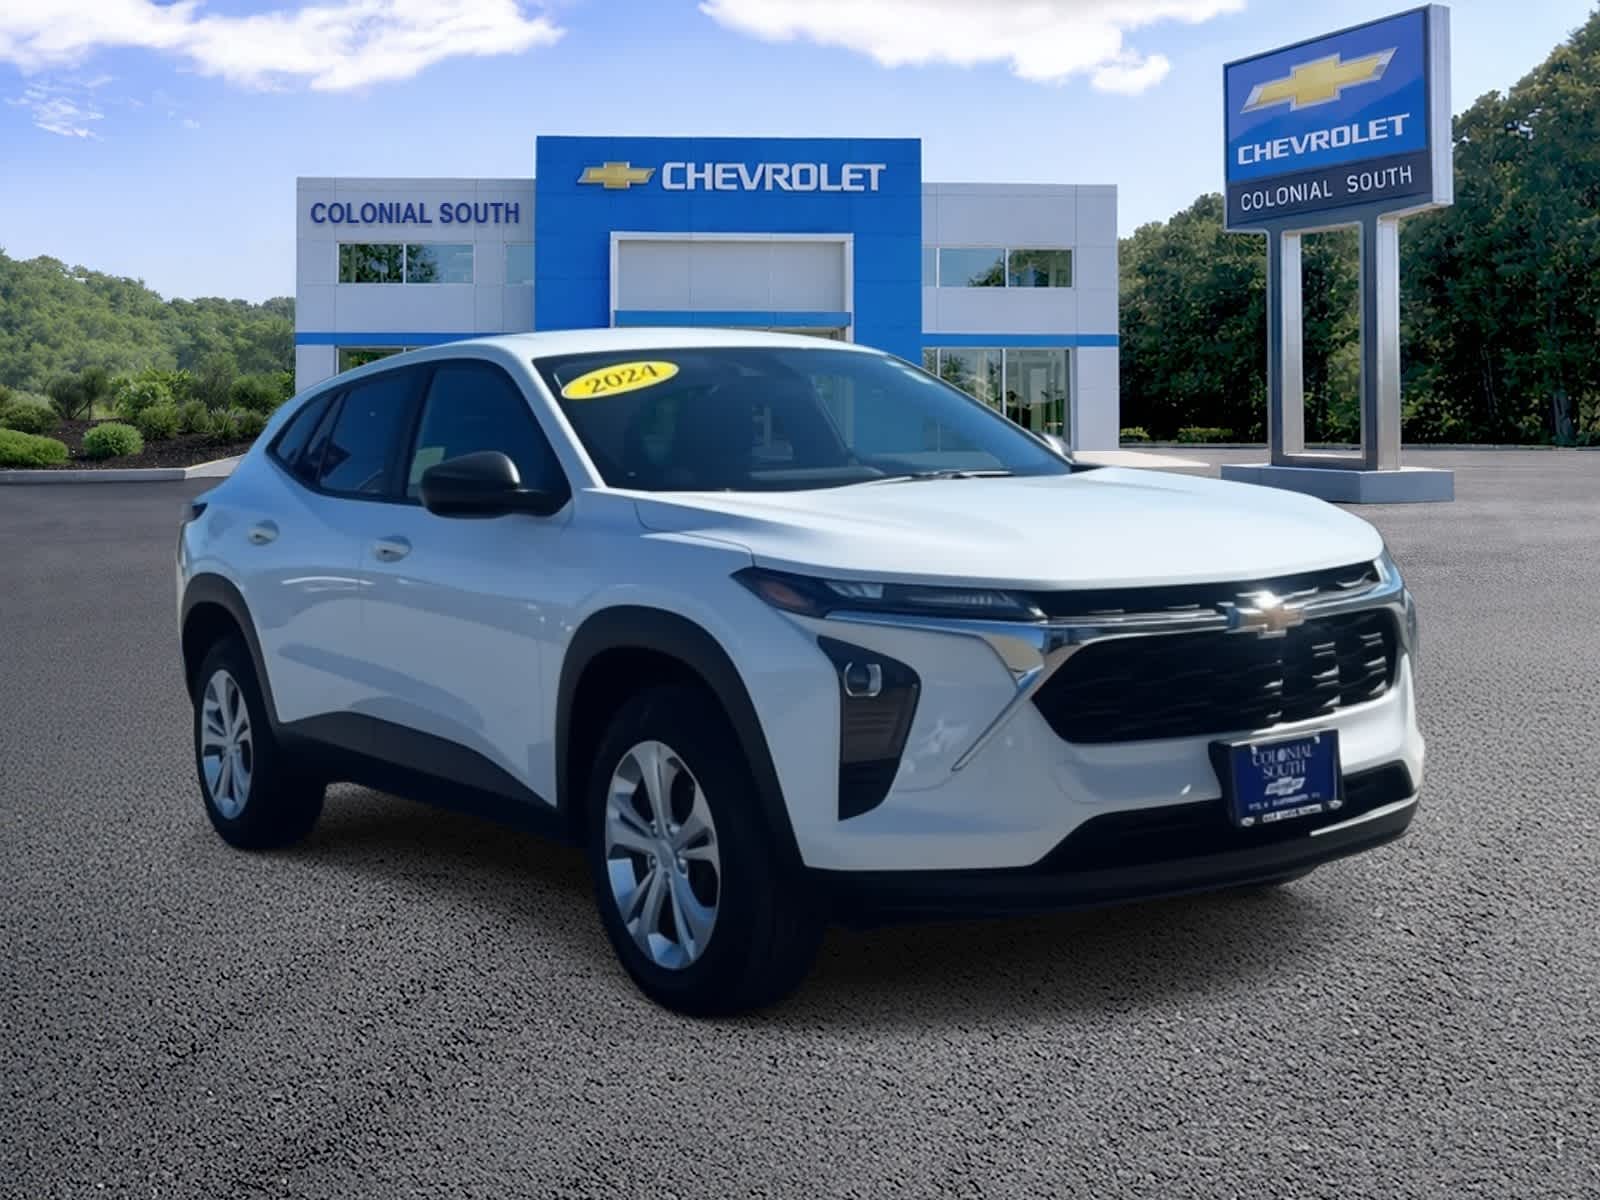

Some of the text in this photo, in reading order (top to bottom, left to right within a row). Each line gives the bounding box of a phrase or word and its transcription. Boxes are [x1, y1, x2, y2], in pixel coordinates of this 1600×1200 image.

[1237, 113, 1410, 165] CHEVROLET
[662, 162, 887, 192] CHEVROLET
[1240, 164, 1412, 211] COLONIAL SOUTH
[310, 202, 520, 224] COLONIAL SOUTH
[584, 364, 659, 394] 2024
[1251, 743, 1312, 767] COLONIAL
[1263, 759, 1306, 780] SOUTH
